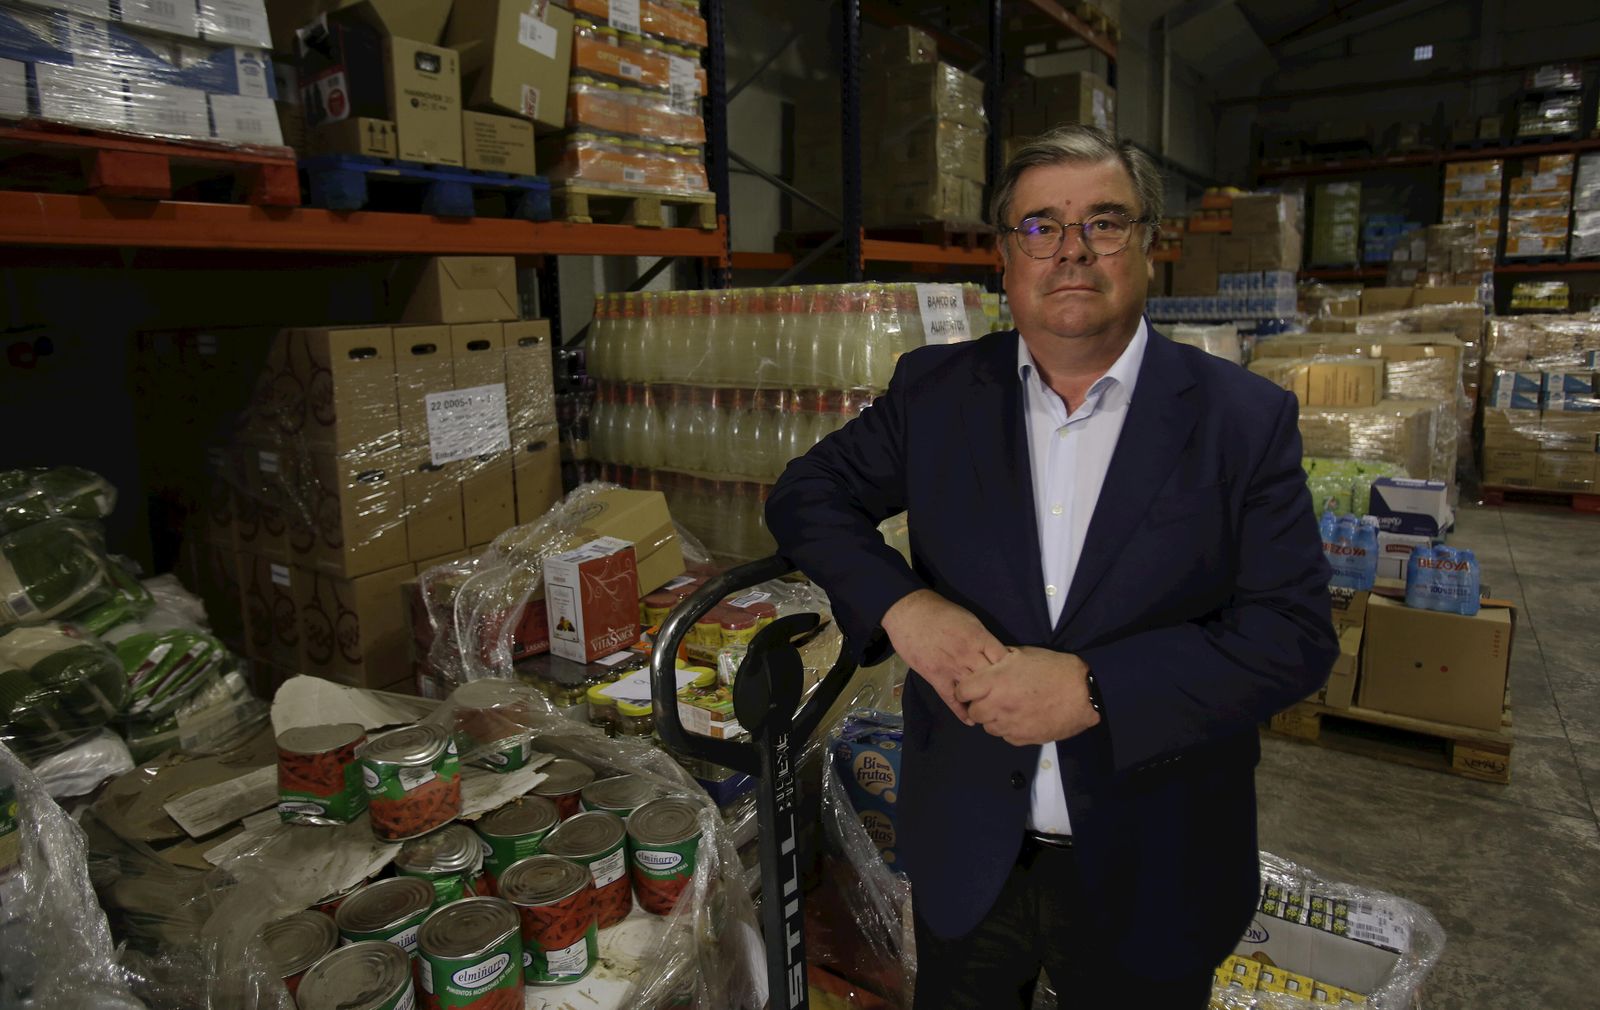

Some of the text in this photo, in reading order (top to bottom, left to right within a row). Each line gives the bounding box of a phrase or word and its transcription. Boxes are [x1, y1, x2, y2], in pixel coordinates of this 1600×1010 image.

[431, 401, 442, 411] 22
[1418, 557, 1469, 571] BEZOYA
[863, 756, 877, 770] Bi
[857, 767, 893, 782] frutas
[864, 815, 877, 829] Bi
[781, 813, 804, 1010] STILL
[458, 956, 507, 982] elmiñarro
